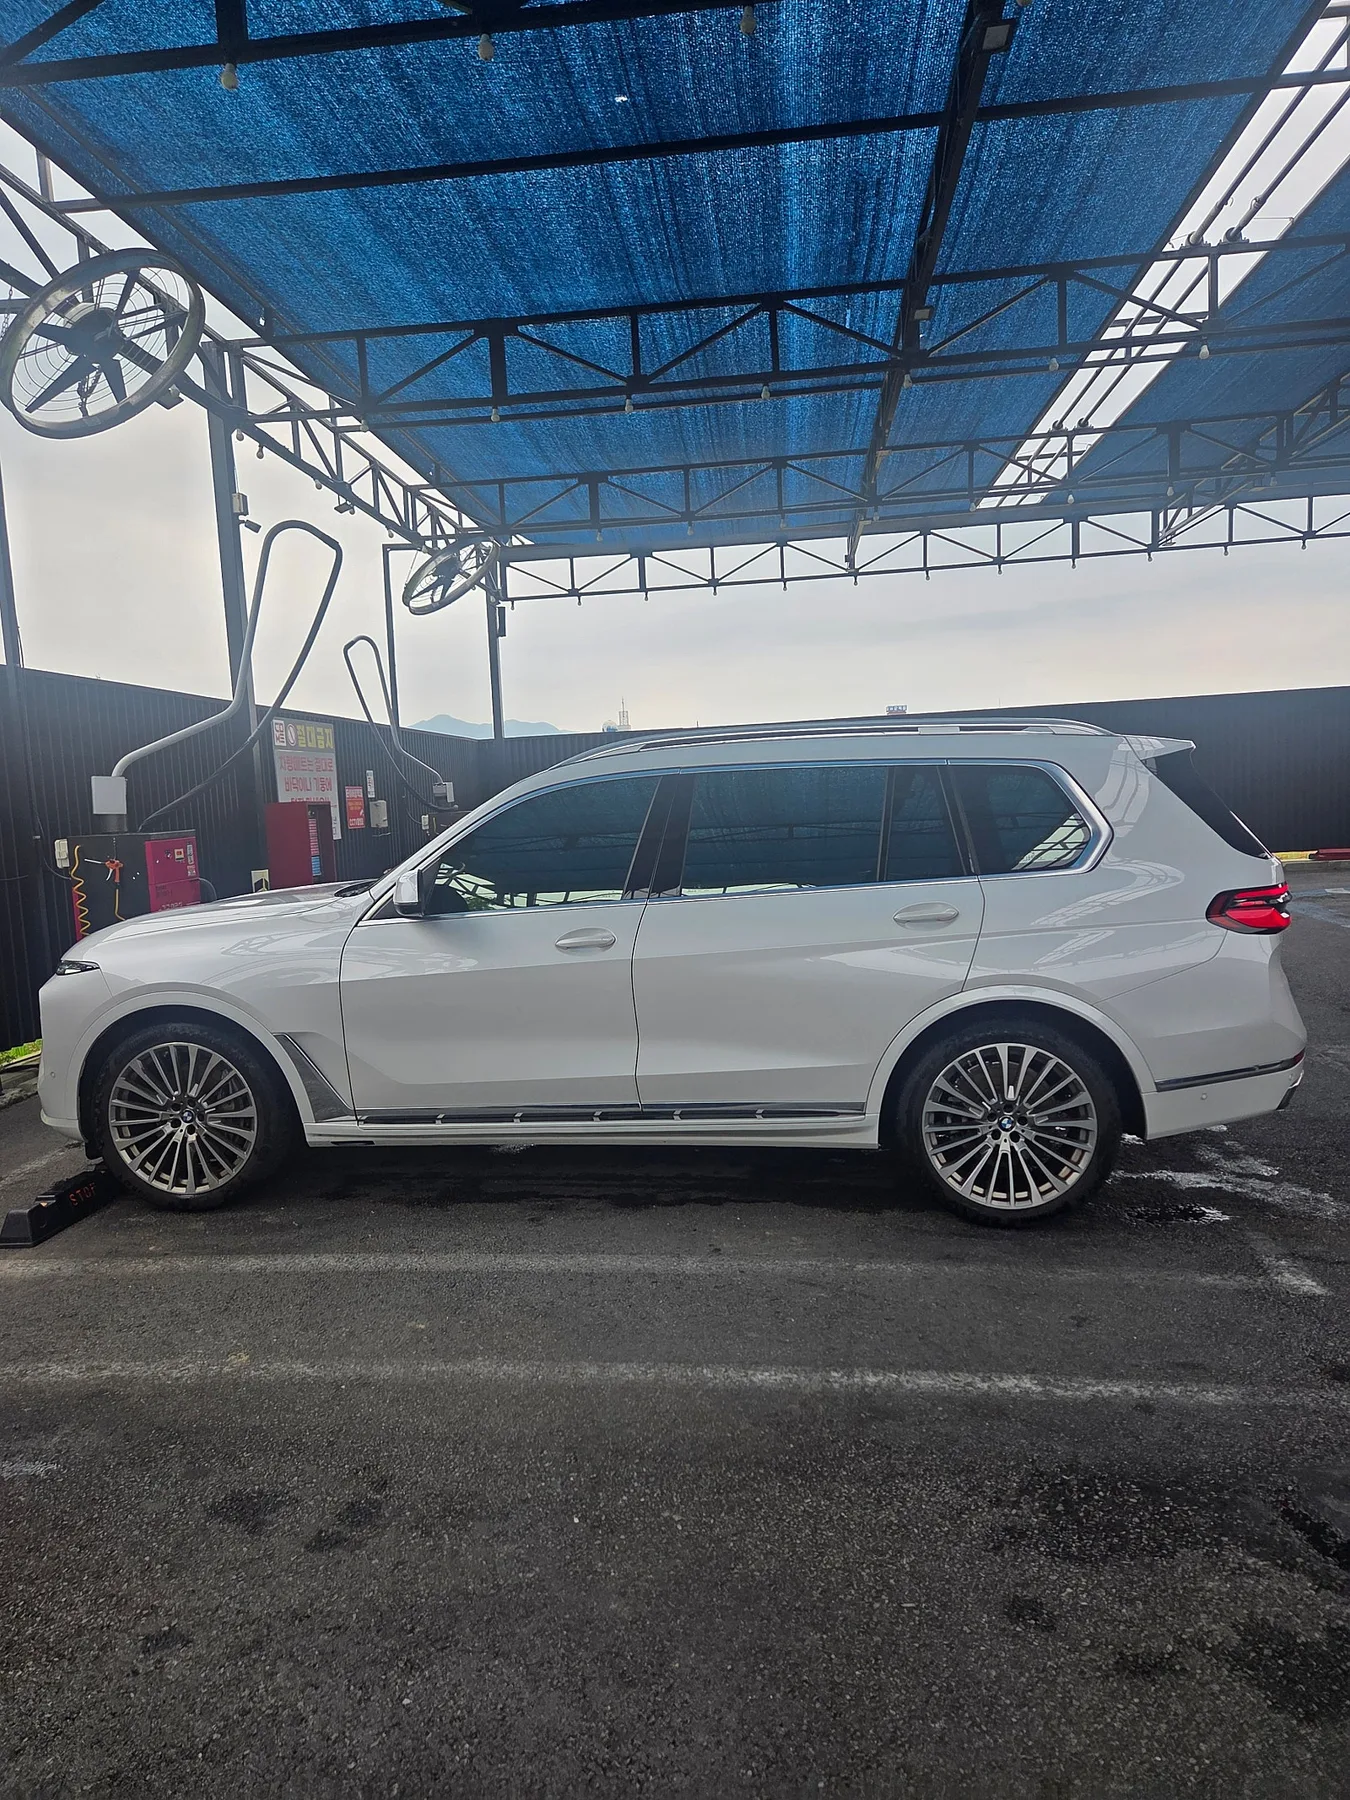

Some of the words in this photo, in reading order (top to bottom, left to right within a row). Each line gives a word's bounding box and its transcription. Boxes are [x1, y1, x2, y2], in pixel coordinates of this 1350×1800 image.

[296, 725, 334, 749] 절대금지
[284, 776, 312, 791] 바닥이나
[313, 777, 332, 792] 기둥에
